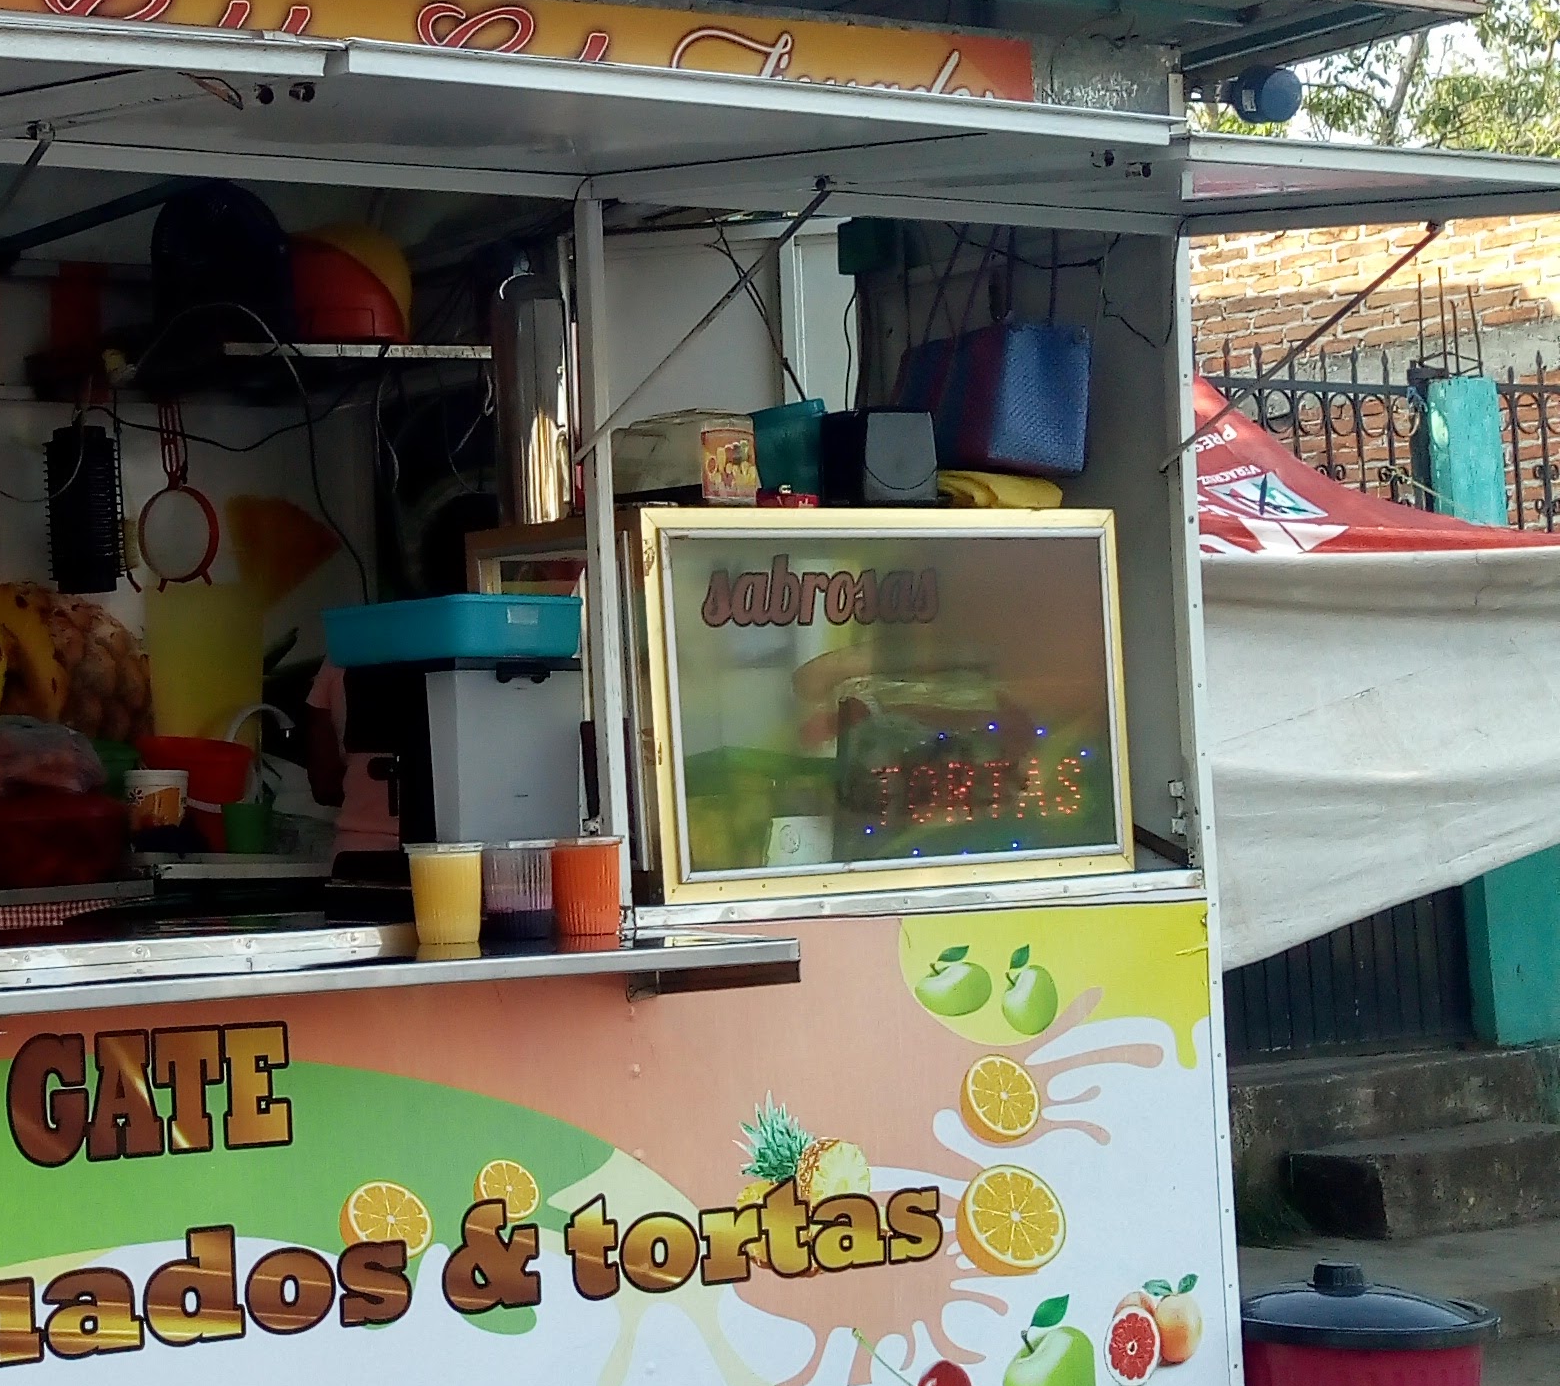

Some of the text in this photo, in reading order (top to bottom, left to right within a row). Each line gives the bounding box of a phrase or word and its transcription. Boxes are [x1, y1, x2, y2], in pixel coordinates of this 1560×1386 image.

[701, 554, 938, 627] sabrosas
[869, 757, 1082, 827] TORTAS
[6, 1020, 294, 1167] GATE
[441, 1198, 541, 1313] &
[565, 1176, 943, 1301] tortas
